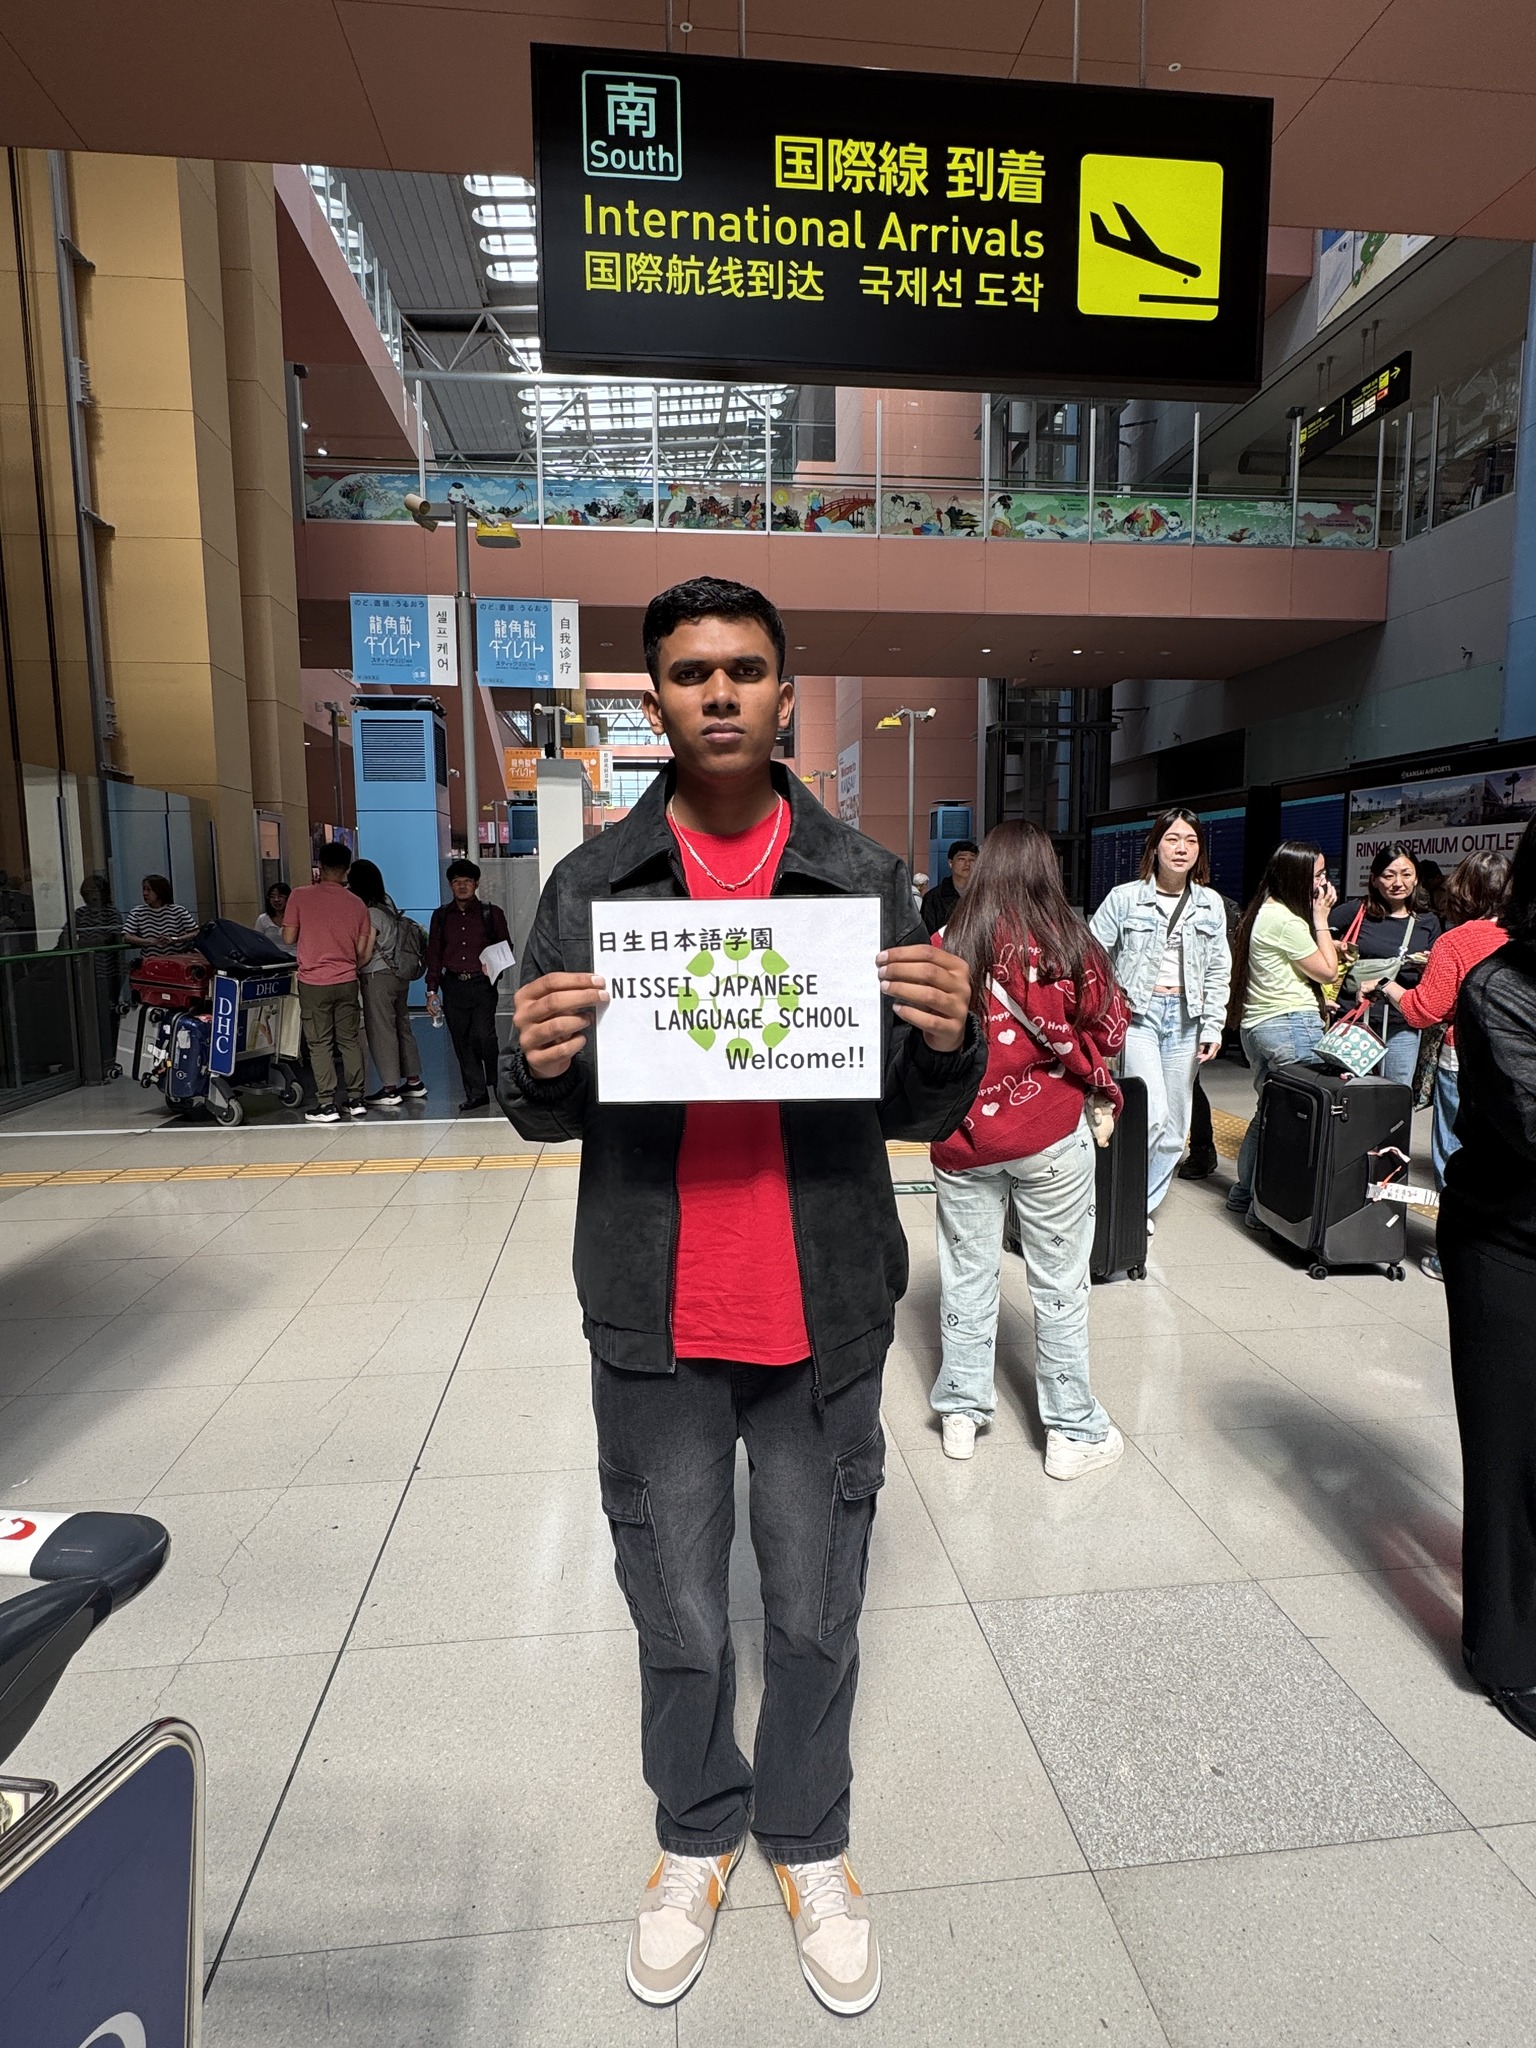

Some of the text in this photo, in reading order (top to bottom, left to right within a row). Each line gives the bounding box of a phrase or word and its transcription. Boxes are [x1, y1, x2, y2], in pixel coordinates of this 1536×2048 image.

[605, 81, 657, 138] 南
[590, 140, 674, 172] South
[775, 135, 1046, 204] 国際線 到着
[584, 194, 1045, 259] International Arrivals
[584, 250, 825, 301] 国際航线到达
[859, 265, 1044, 313] 국제선 도착
[368, 615, 413, 635] 龍角散
[494, 619, 536, 639] 龍角散
[363, 636, 421, 656] ダイレクト
[436, 610, 449, 671] 셀프케어
[488, 640, 545, 660] ダイレクト
[559, 617, 572, 674] 自我诊疗
[599, 927, 773, 953] 日生日本語学園
[256, 982, 280, 996] DHC
[611, 974, 818, 999] NISSEI JAPANESE
[216, 997, 232, 1054] DHC
[654, 1006, 860, 1030] LANGUAGE SCHOOL
[725, 1046, 865, 1070] Welcome!!
